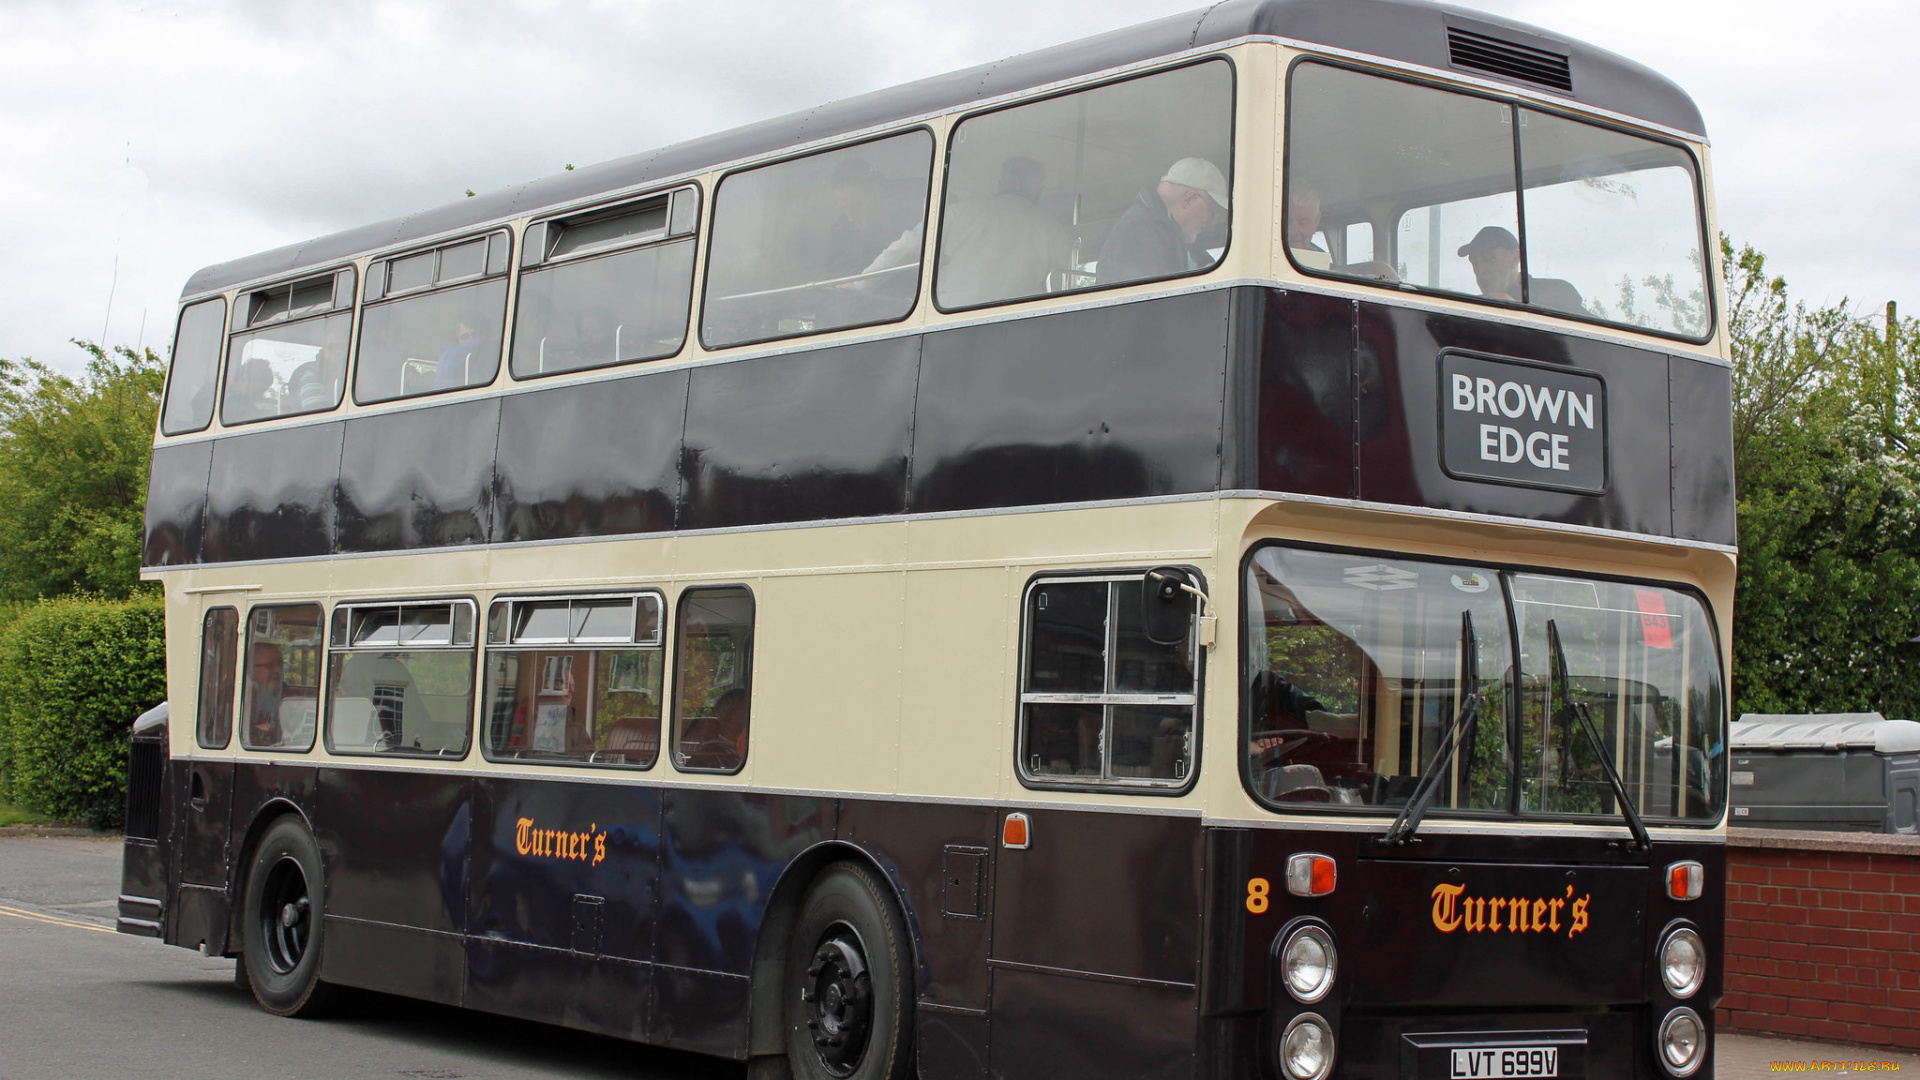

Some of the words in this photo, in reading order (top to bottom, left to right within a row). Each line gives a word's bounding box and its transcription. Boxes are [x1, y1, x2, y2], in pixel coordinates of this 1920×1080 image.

[1452, 373, 1594, 430] BROWN
[1480, 423, 1570, 471] EDGE
[515, 816, 608, 868] Turner's
[1246, 877, 1270, 914] 8
[1431, 882, 1591, 940] Turner's
[1452, 1051, 1496, 1077] LVT
[1501, 1050, 1557, 1076] 699V
